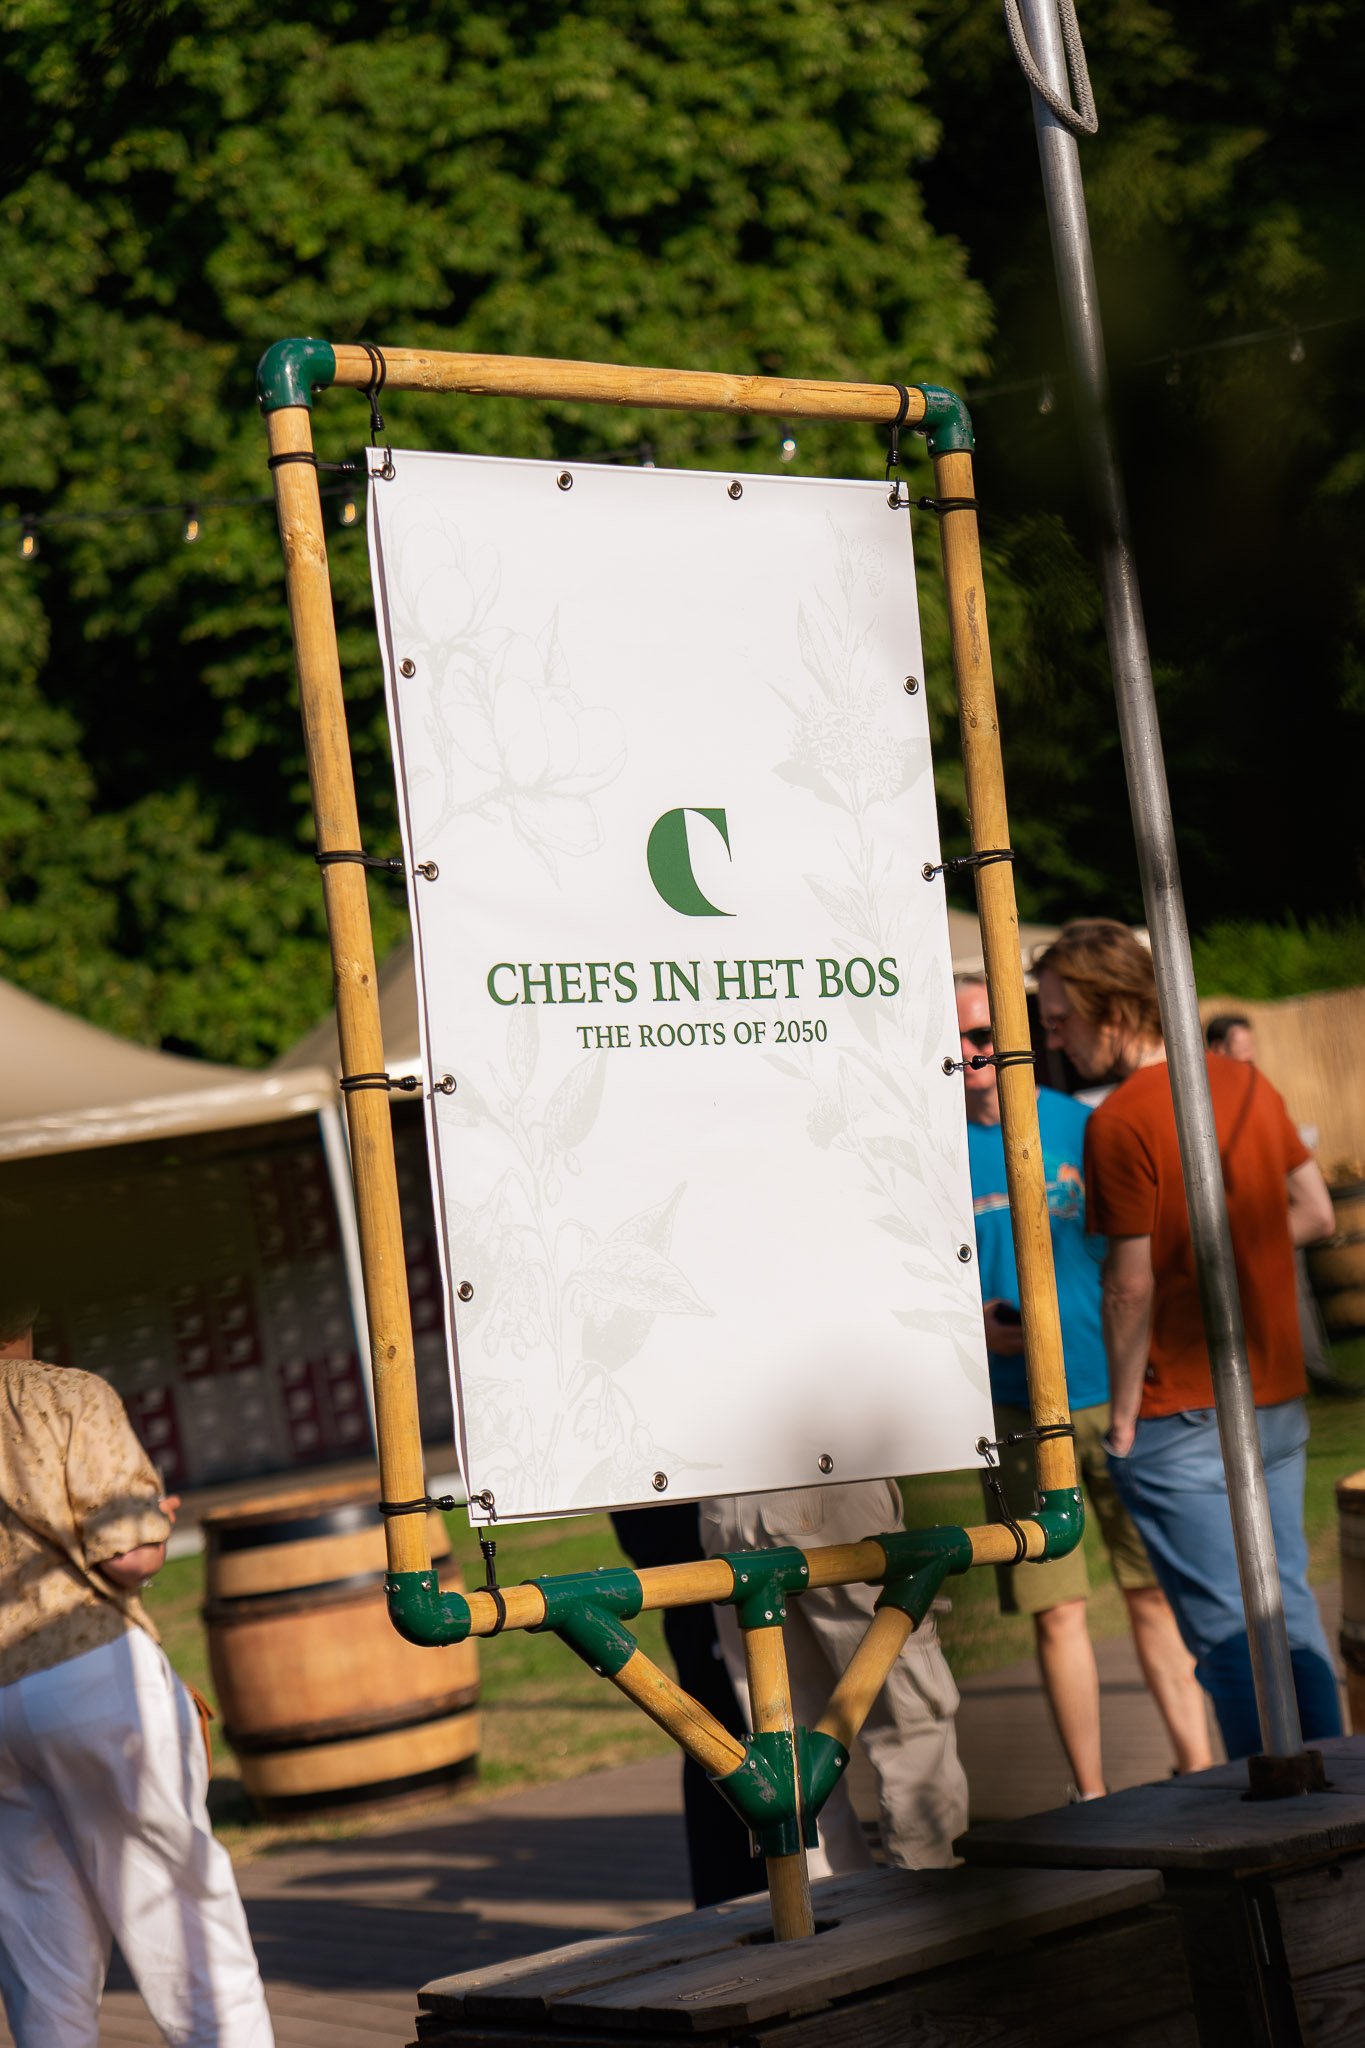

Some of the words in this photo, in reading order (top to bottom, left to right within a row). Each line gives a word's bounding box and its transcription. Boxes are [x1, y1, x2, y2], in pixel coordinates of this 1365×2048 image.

[647, 808, 737, 917] C
[486, 962, 638, 1006] CHEFS
[650, 961, 701, 1002] IN
[714, 958, 805, 1001] HET
[816, 957, 901, 998] BOS
[576, 1025, 632, 1049] THE
[638, 1023, 726, 1048] ROOTS
[733, 1021, 766, 1044] OF
[773, 1019, 828, 1043] 2050
